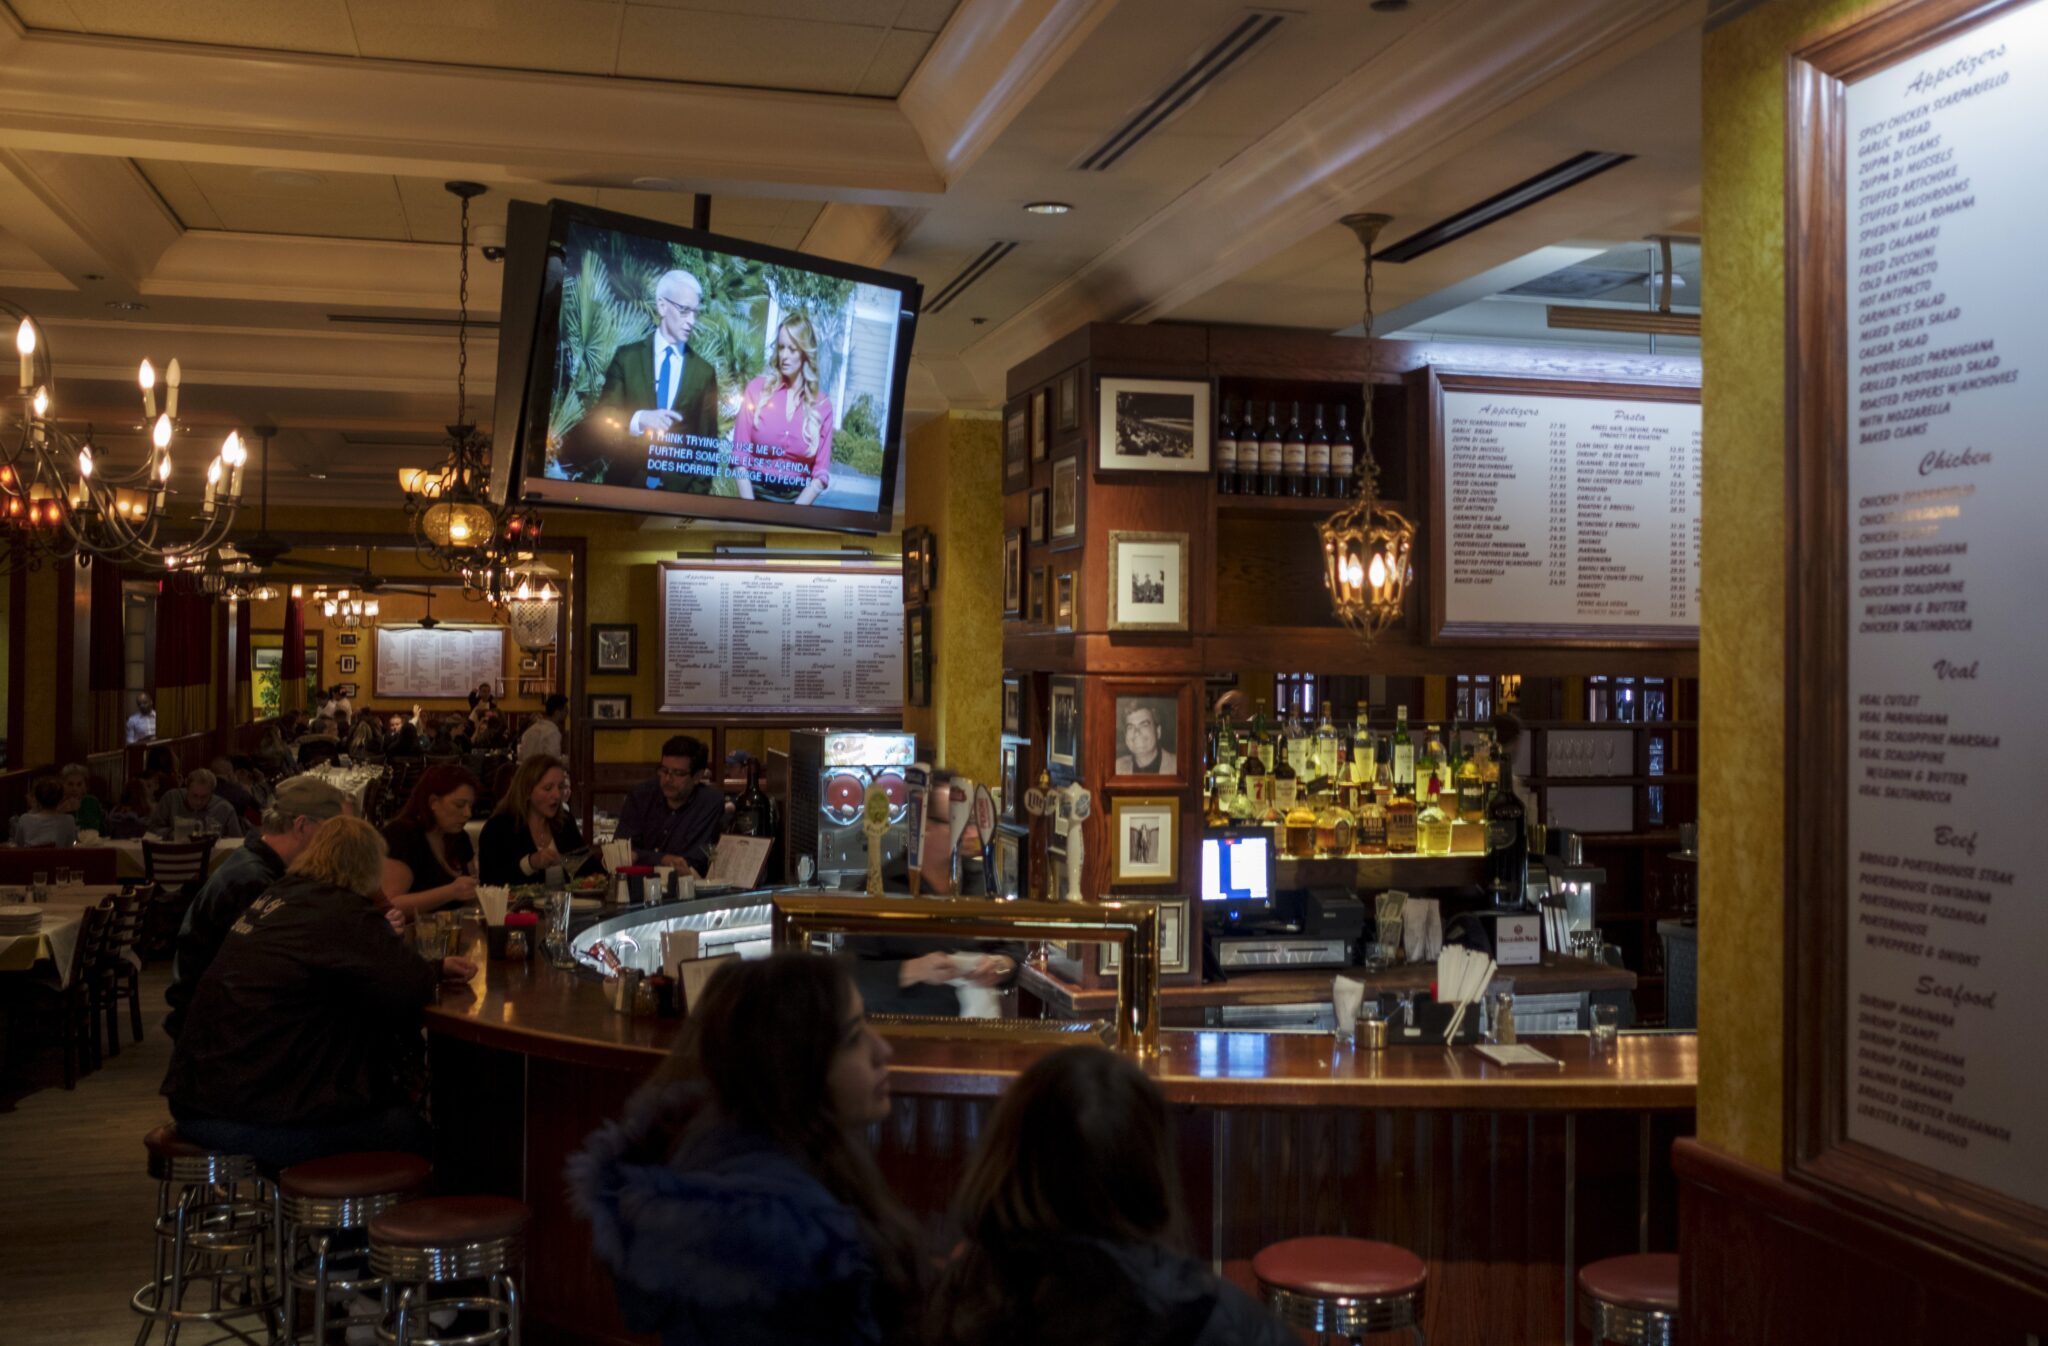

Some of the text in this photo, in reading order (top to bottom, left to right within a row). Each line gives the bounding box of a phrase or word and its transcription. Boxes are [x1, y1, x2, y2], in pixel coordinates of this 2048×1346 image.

[1905, 44, 2005, 96] Appetizers
[1859, 72, 2008, 142] SPICY CHICKEN SCARPARIELLO
[1858, 121, 1930, 158] GARLIC BREAD
[1859, 135, 1940, 175] ZUPPA DI CLAMS
[1859, 148, 1953, 192] ZUPPA DI MUSSELS
[1859, 165, 1957, 209] STUFFED ARTICHOKE
[1859, 178, 1969, 226] STUFFED MUSHROOMS
[1860, 196, 1974, 242] SPIEDINI ALLA ROMANA
[1859, 227, 1939, 259] FRIED CALAMARI
[1859, 246, 1935, 277] FRIED ZUCCHINI
[1859, 261, 1938, 293] COLD ANTIPASTO
[1859, 280, 1931, 308] HOT ANTIPASTO
[1859, 293, 1945, 325] CARMINE'S SALAD
[1860, 307, 1960, 341] MIXED GREEN SALAD
[1859, 334, 1928, 360] CAESAR SALAD
[1860, 340, 1993, 376] PORTOBELLOS PARMIGIANA
[1859, 356, 2000, 394] GRILLED PORTOBELLO SALAD
[1860, 393, 1899, 411] ROASTED
[1903, 384, 1944, 402] PEPPERS
[1479, 404, 1538, 417] Appetizers
[1615, 410, 1645, 421] Pasta
[1859, 402, 1950, 427] WITH MOZZARELLA
[656, 431, 683, 445] THINK
[686, 435, 719, 449] TRYING
[736, 441, 754, 453] USE
[756, 443, 769, 455] ME
[1860, 423, 1928, 444] BAKED CLAMS
[649, 445, 693, 460] FURTHER
[695, 451, 740, 465] SOMEONE
[742, 456, 773, 469] ELSE'S
[1918, 448, 1990, 476] Chicken
[647, 459, 675, 472] DOES
[676, 461, 721, 477] HORRIBLE
[725, 468, 762, 482] DAMAGE
[764, 473, 777, 484] TO
[1859, 494, 1899, 509] CHICKEN
[1859, 531, 1899, 544] CHICKEN
[1859, 543, 1967, 561] CHICKEN PARMIGIANA
[1860, 564, 1950, 580] CHICKEN MARSALA
[1860, 585, 1900, 597] CHICKEN
[1927, 600, 1967, 613] BUTTER
[1860, 621, 1900, 633] CHICKEN
[1933, 659, 1979, 680] Veal
[1859, 694, 1920, 707] VEAL CUTLET
[1859, 712, 1880, 723] VEAL
[1859, 730, 1880, 741] VEAL
[1948, 735, 2000, 748] MARSALA
[1859, 748, 1880, 759] VEAL
[1859, 785, 1880, 797] VEAL
[1927, 771, 1967, 786] BUTTER
[1934, 826, 1977, 856] Beef
[1915, 976, 1996, 1009] Seafood
